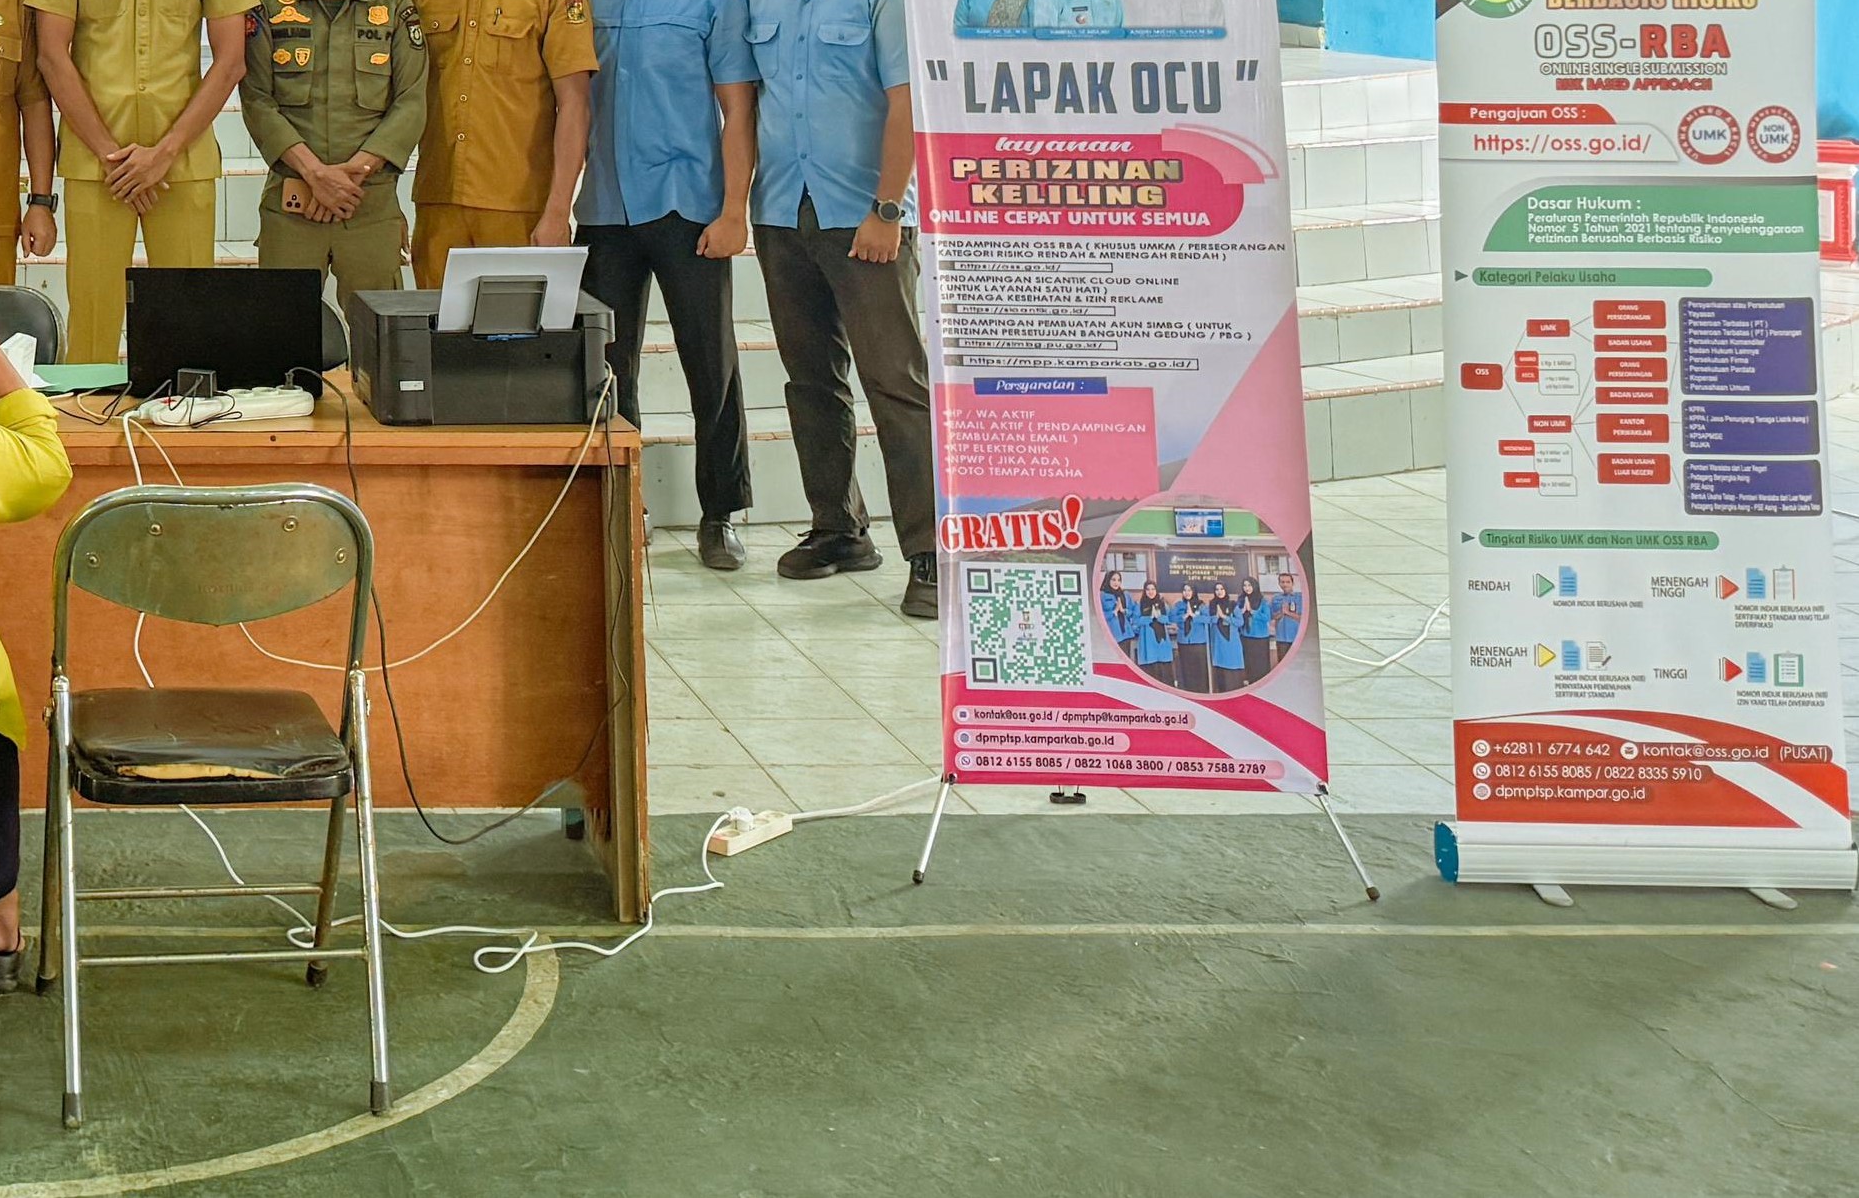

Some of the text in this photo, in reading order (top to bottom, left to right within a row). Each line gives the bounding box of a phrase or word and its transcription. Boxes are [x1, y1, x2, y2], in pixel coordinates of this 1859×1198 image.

[1539, 62, 1725, 75] ONLINE SINGLE SUBMISSION
[962, 60, 1221, 114] LAPAK OCU
[1470, 107, 1578, 121] Pengajuan OSS
[1692, 128, 1729, 140] UMK
[1763, 124, 1784, 133] NON
[995, 136, 1133, 154] layanan
[1474, 134, 1651, 155] https://oss.go.id/
[1757, 134, 1791, 144] UMK
[950, 159, 1178, 182] PERIZINAN
[969, 184, 1165, 207] KELILING
[1528, 197, 1631, 210] Dasar Hukum
[929, 209, 1210, 226] ONLINE CEPAT UNTUK SEMUA
[1527, 214, 1764, 224] Peraturan Pemerintah Republik Indonesia
[1528, 234, 1722, 244] Perizinan Berusaha Berbasis Risiko
[1486, 534, 1707, 546] Tingkat Risiko UMK dan Non UMK OSS RBA
[1468, 580, 1510, 591] RENDAH
[1651, 577, 1708, 588] MENENGAH
[1651, 588, 1685, 598] TINGGI
[1469, 646, 1527, 657] MENENGAH
[1469, 657, 1511, 667] RENDAH
[1653, 669, 1687, 679] TINGGI
[975, 732, 1113, 747] dpmptsp.kamparkab.go.id
[1494, 743, 1609, 755] +62811 6774 642
[1643, 745, 1768, 759] kontak@oss.go.id
[976, 756, 1265, 774] 0812 6155 8085 0822 1068 3800 0853 7588 2789
[1495, 766, 1701, 780] 0812 6155 8085 0822 8335 5910
[1495, 786, 1645, 800] dpmptsp.kampar.go.id
